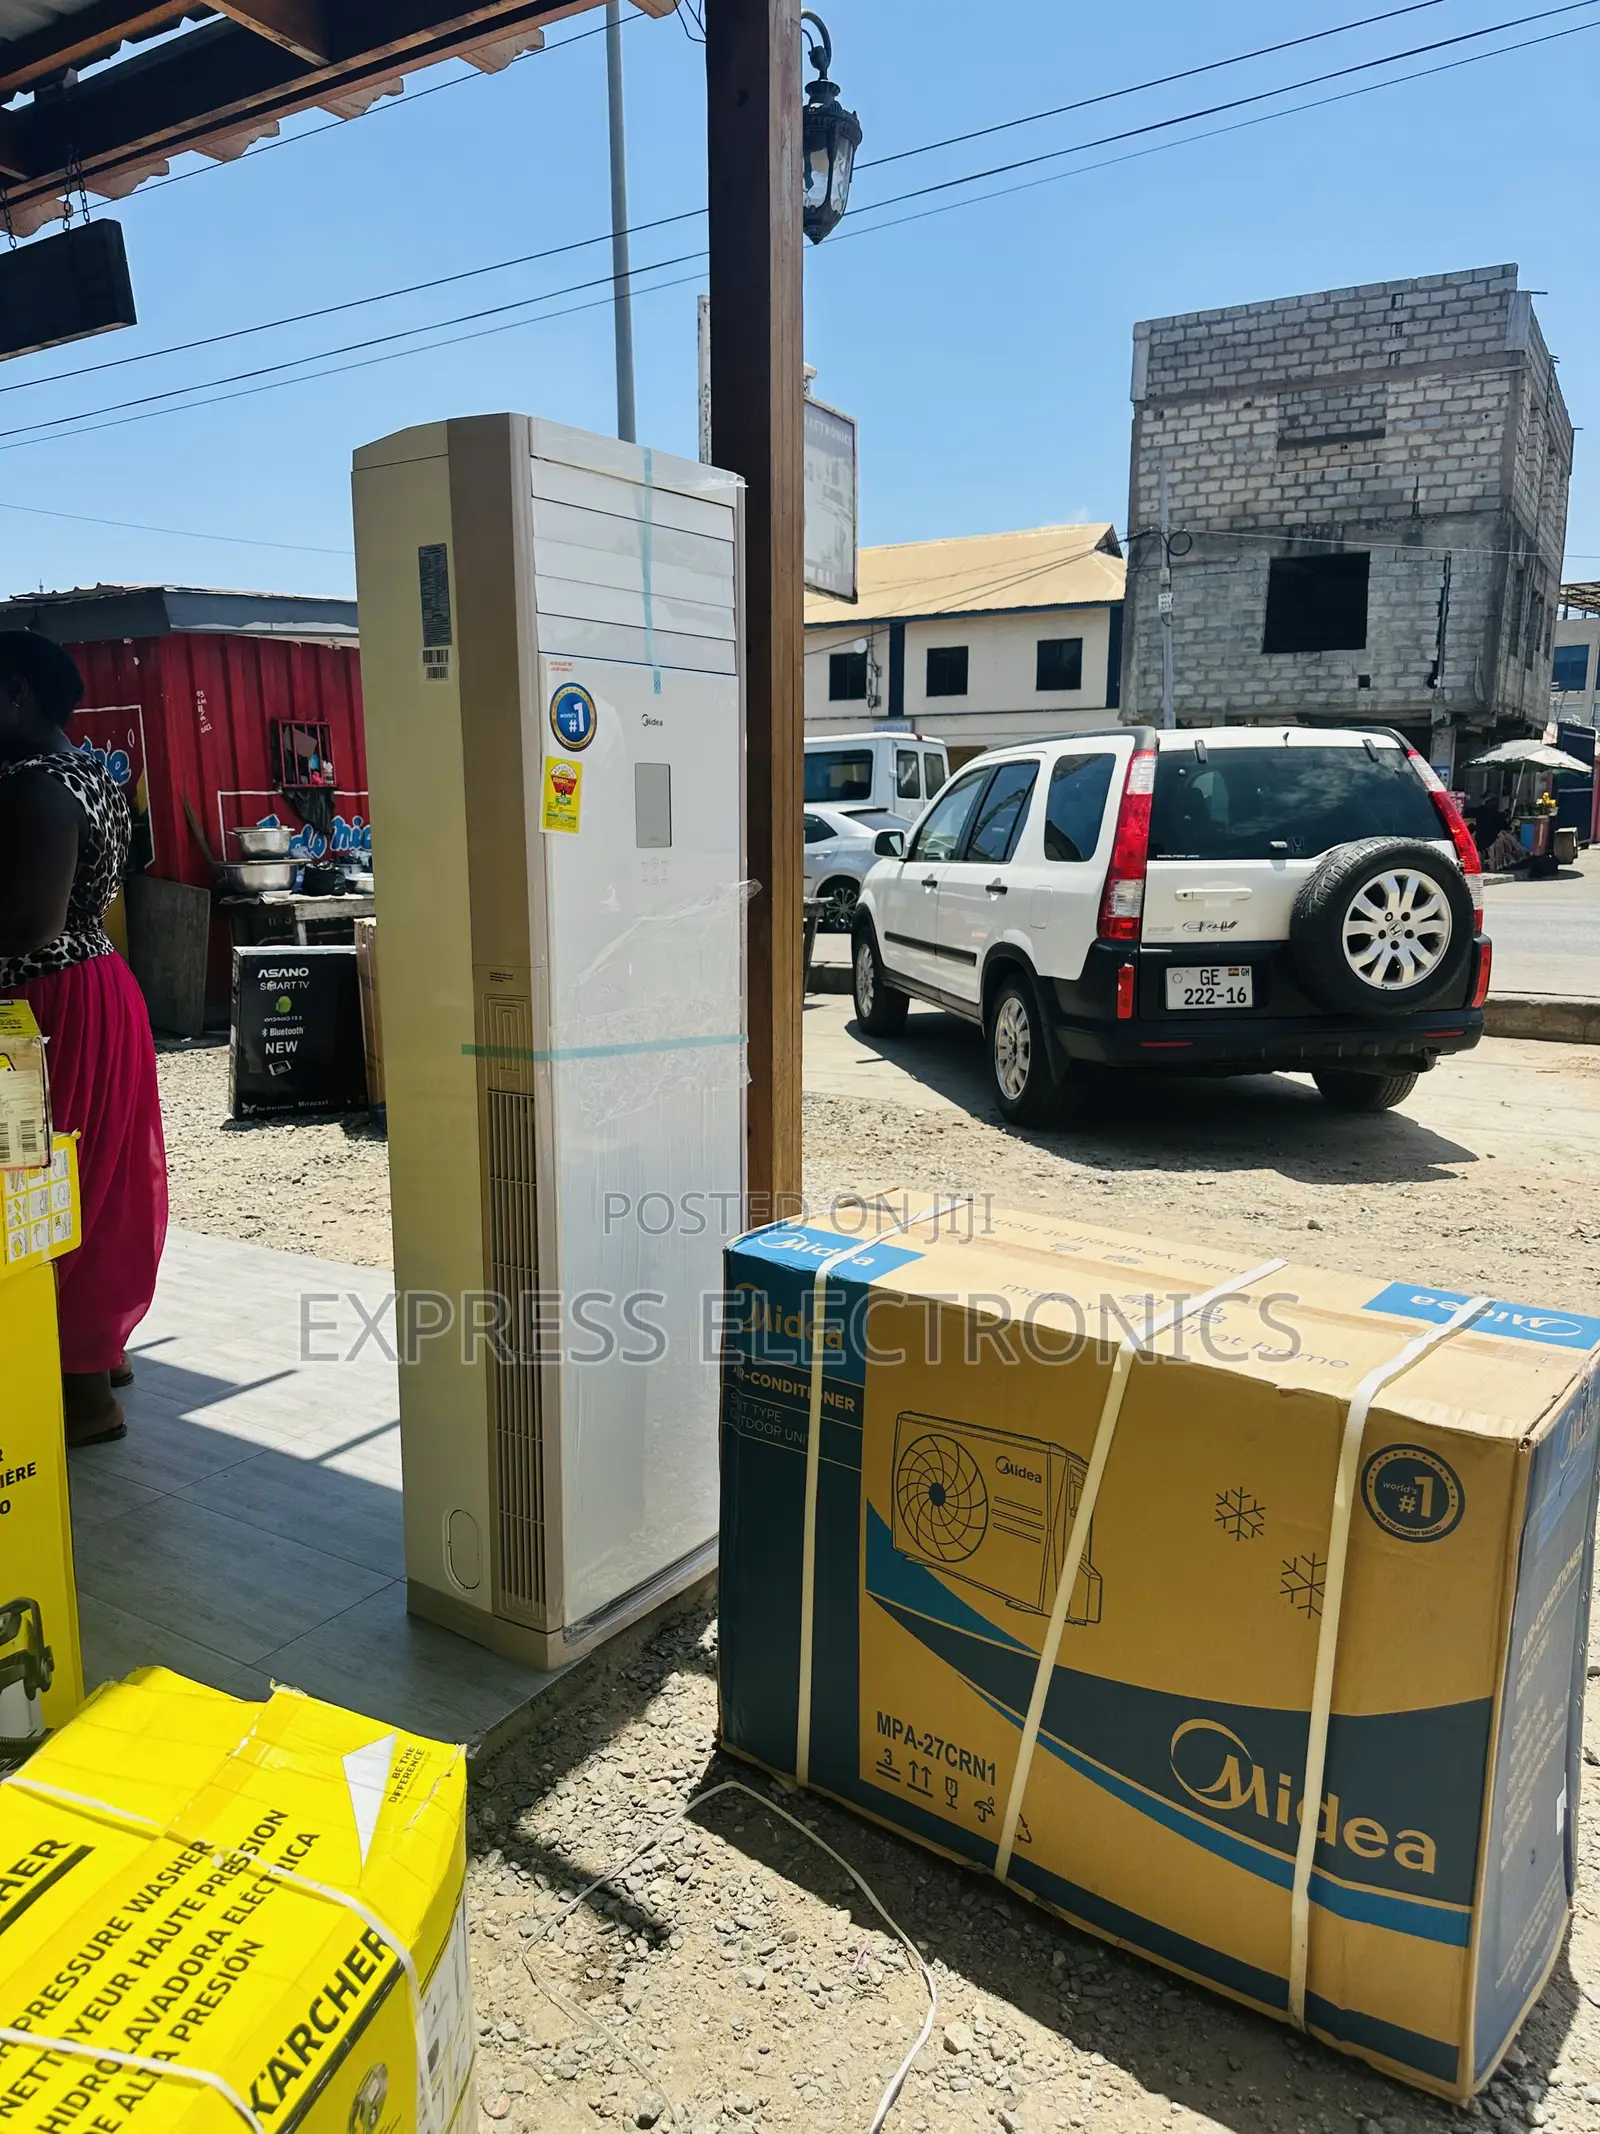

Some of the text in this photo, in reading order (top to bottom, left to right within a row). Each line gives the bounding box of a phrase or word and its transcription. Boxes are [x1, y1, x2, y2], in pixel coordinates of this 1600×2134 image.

[641, 713, 664, 727] Midea
[257, 967, 310, 979] ASANO
[1200, 967, 1250, 986] GE GH
[298, 980, 310, 989] TV
[1184, 987, 1247, 1005] 222-16
[269, 1026, 304, 1037] Bluetooth
[265, 1040, 298, 1055] NEW
[752, 1404, 782, 1423] TYPE
[996, 1455, 1042, 1484] Midea
[1382, 1481, 1418, 1495] world's
[876, 1710, 996, 1786] MPA-27CRN1
[391, 1765, 404, 1780] BE
[399, 1747, 415, 1765] THE
[388, 1749, 425, 1803] DIFFERENCE
[9, 1839, 215, 2033] PRESSURE WASHER
[135, 1897, 208, 1971] HAUTE
[168, 1938, 265, 2043] PRESIÓN
[249, 1926, 390, 2115] KÄRCHER
